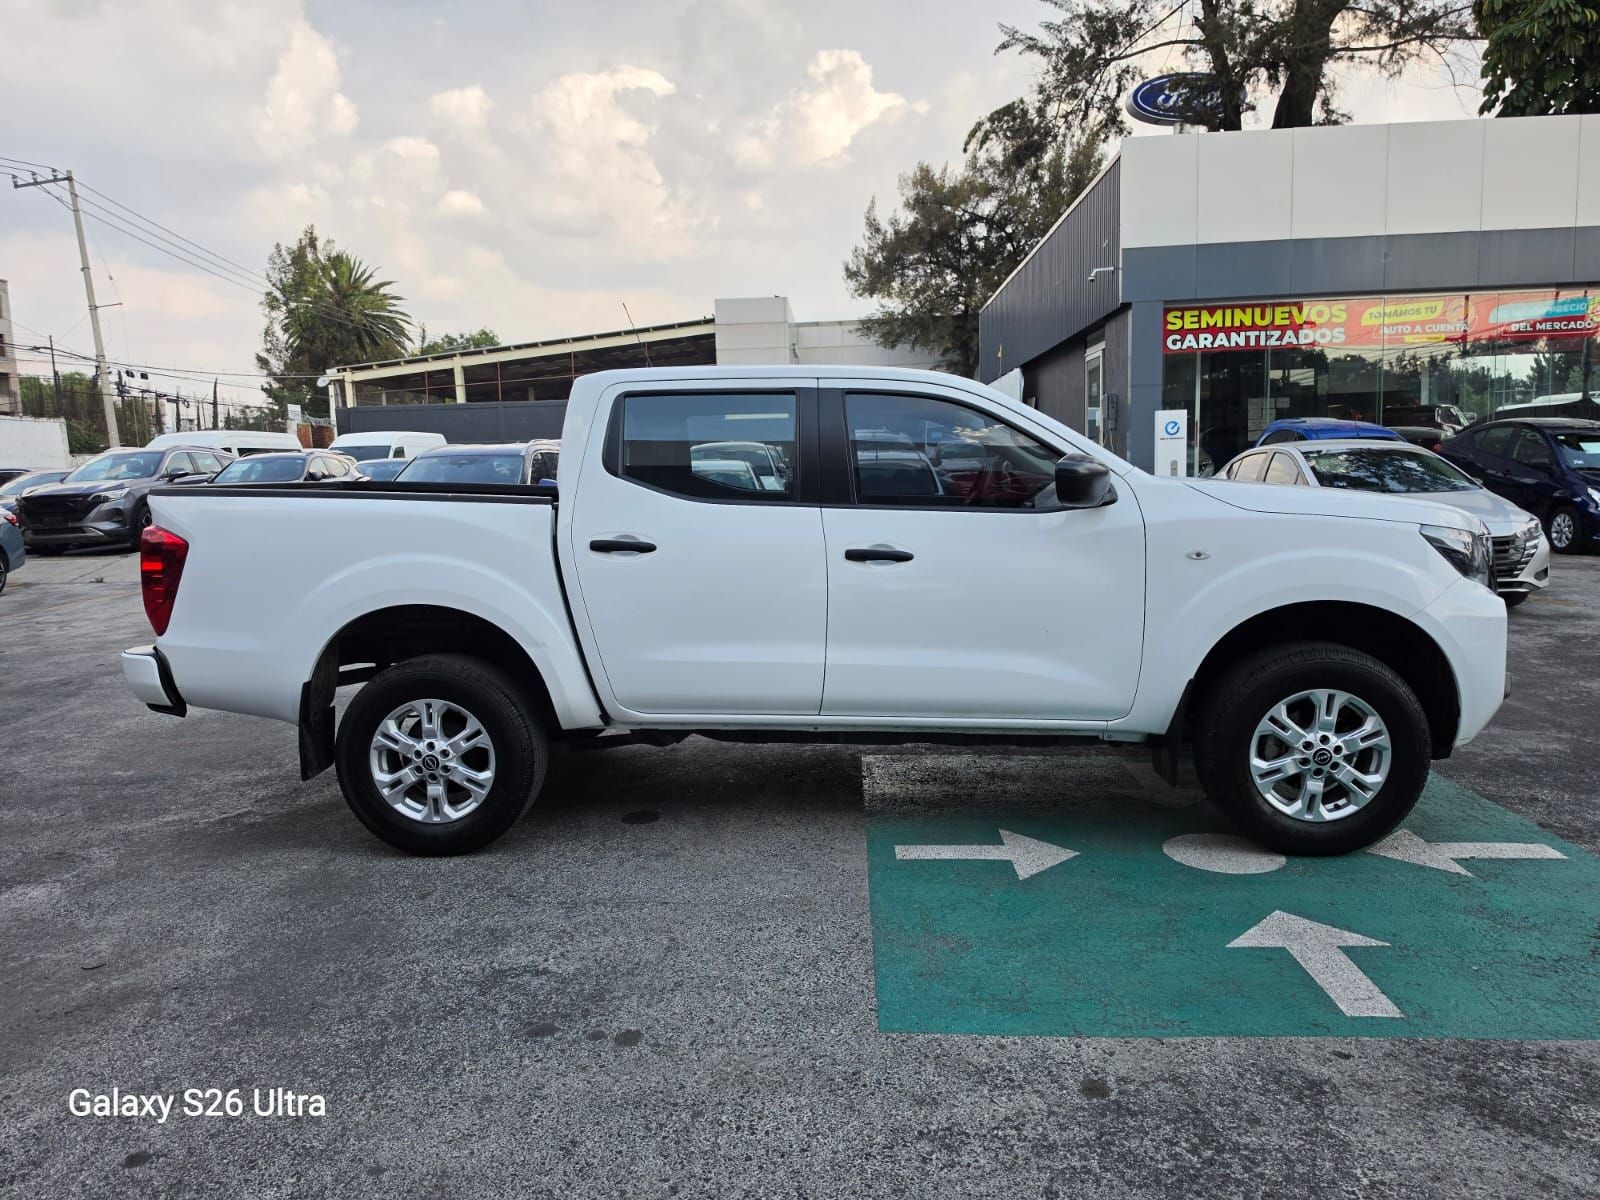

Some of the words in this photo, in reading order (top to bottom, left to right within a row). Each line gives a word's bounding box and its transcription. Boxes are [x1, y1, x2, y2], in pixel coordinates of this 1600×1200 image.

[1424, 305, 1437, 314] TU
[1166, 303, 1348, 330] SEMINUEVOS
[1381, 325, 1411, 334] AUTO
[1414, 324, 1423, 333] A
[1425, 322, 1469, 333] CUENTA
[1511, 322, 1533, 331] DEL
[1536, 320, 1594, 330] MERCADO
[1166, 327, 1346, 350] GARANTIZADOS
